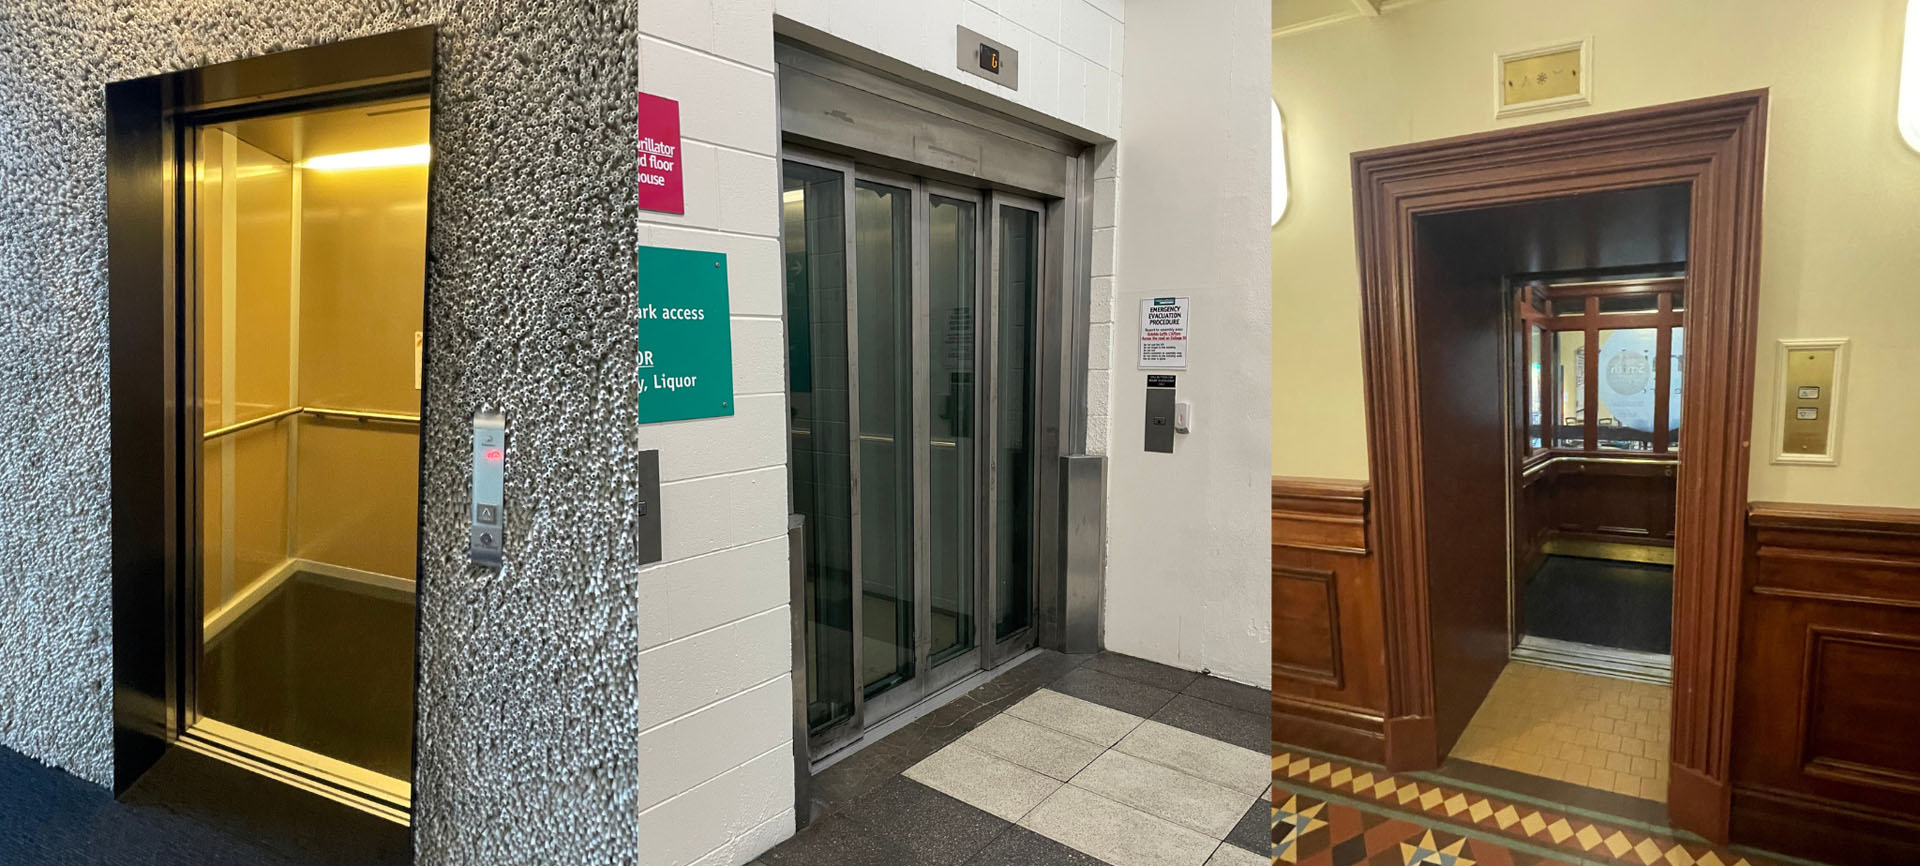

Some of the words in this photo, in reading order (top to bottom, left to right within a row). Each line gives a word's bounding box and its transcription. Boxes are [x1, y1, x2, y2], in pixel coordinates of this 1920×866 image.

[649, 155, 674, 171] floor
[662, 308, 705, 320] access
[653, 373, 697, 391] Liquor
